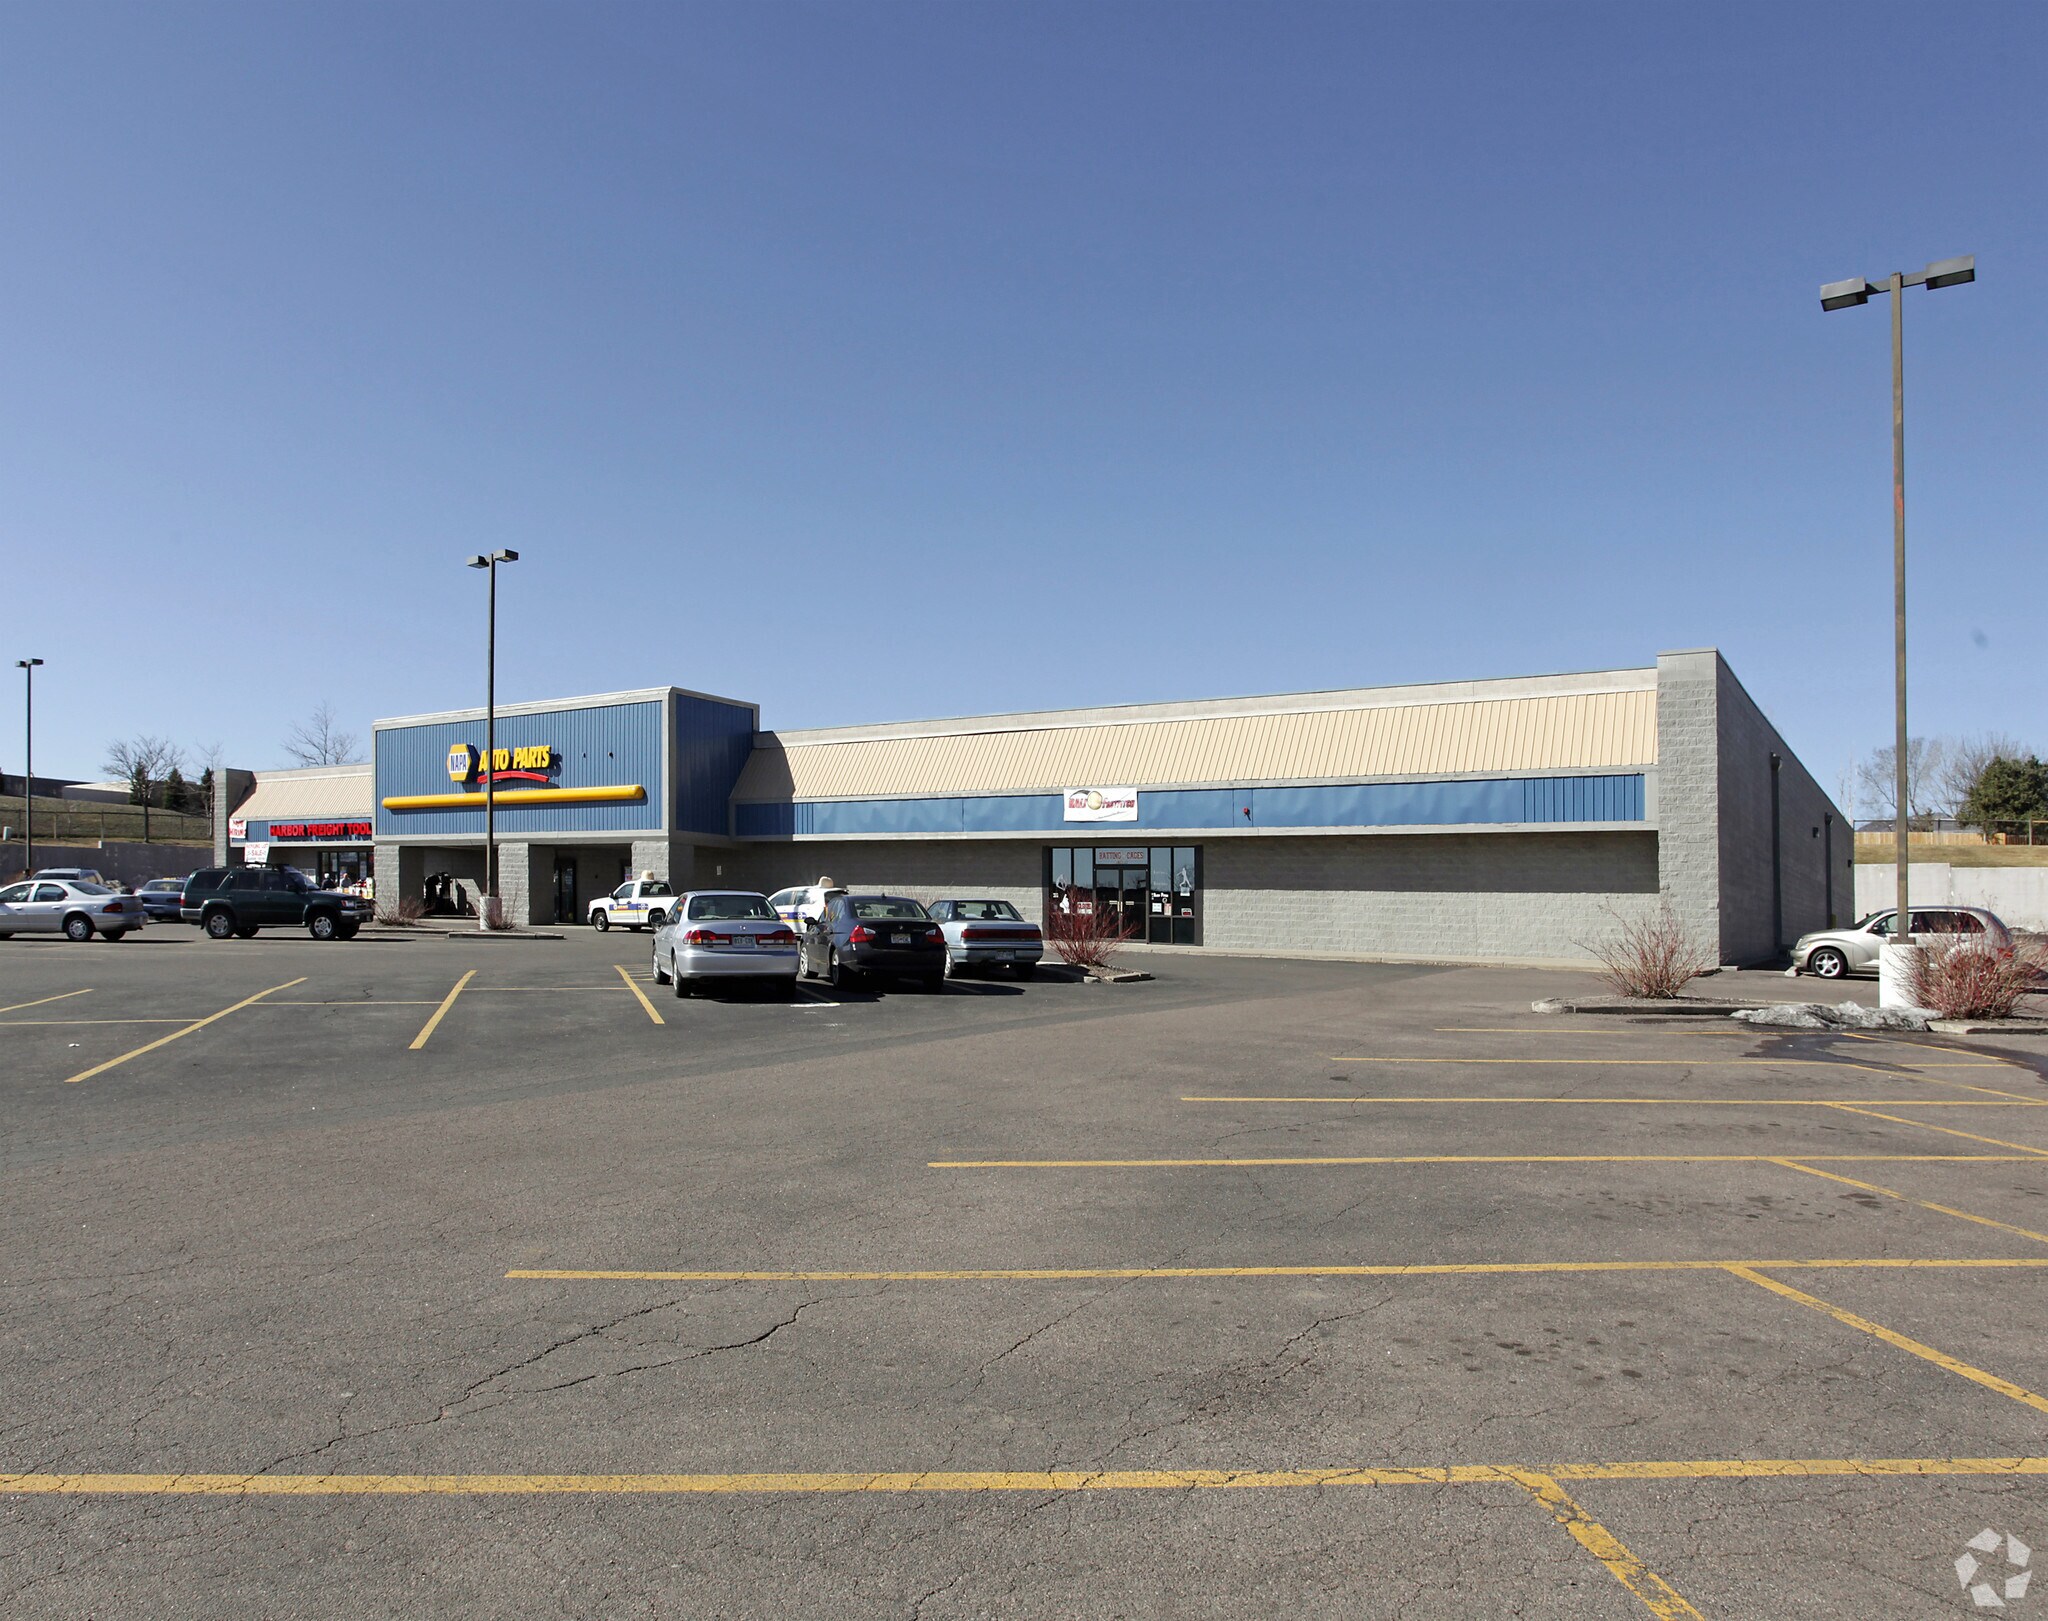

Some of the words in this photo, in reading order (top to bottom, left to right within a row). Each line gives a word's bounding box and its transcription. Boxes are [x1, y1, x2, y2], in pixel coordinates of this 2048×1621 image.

[450, 753, 467, 771] NAPA
[513, 745, 550, 769] PARTS
[270, 825, 304, 836] HARBOR
[307, 823, 344, 836] FREIGHT
